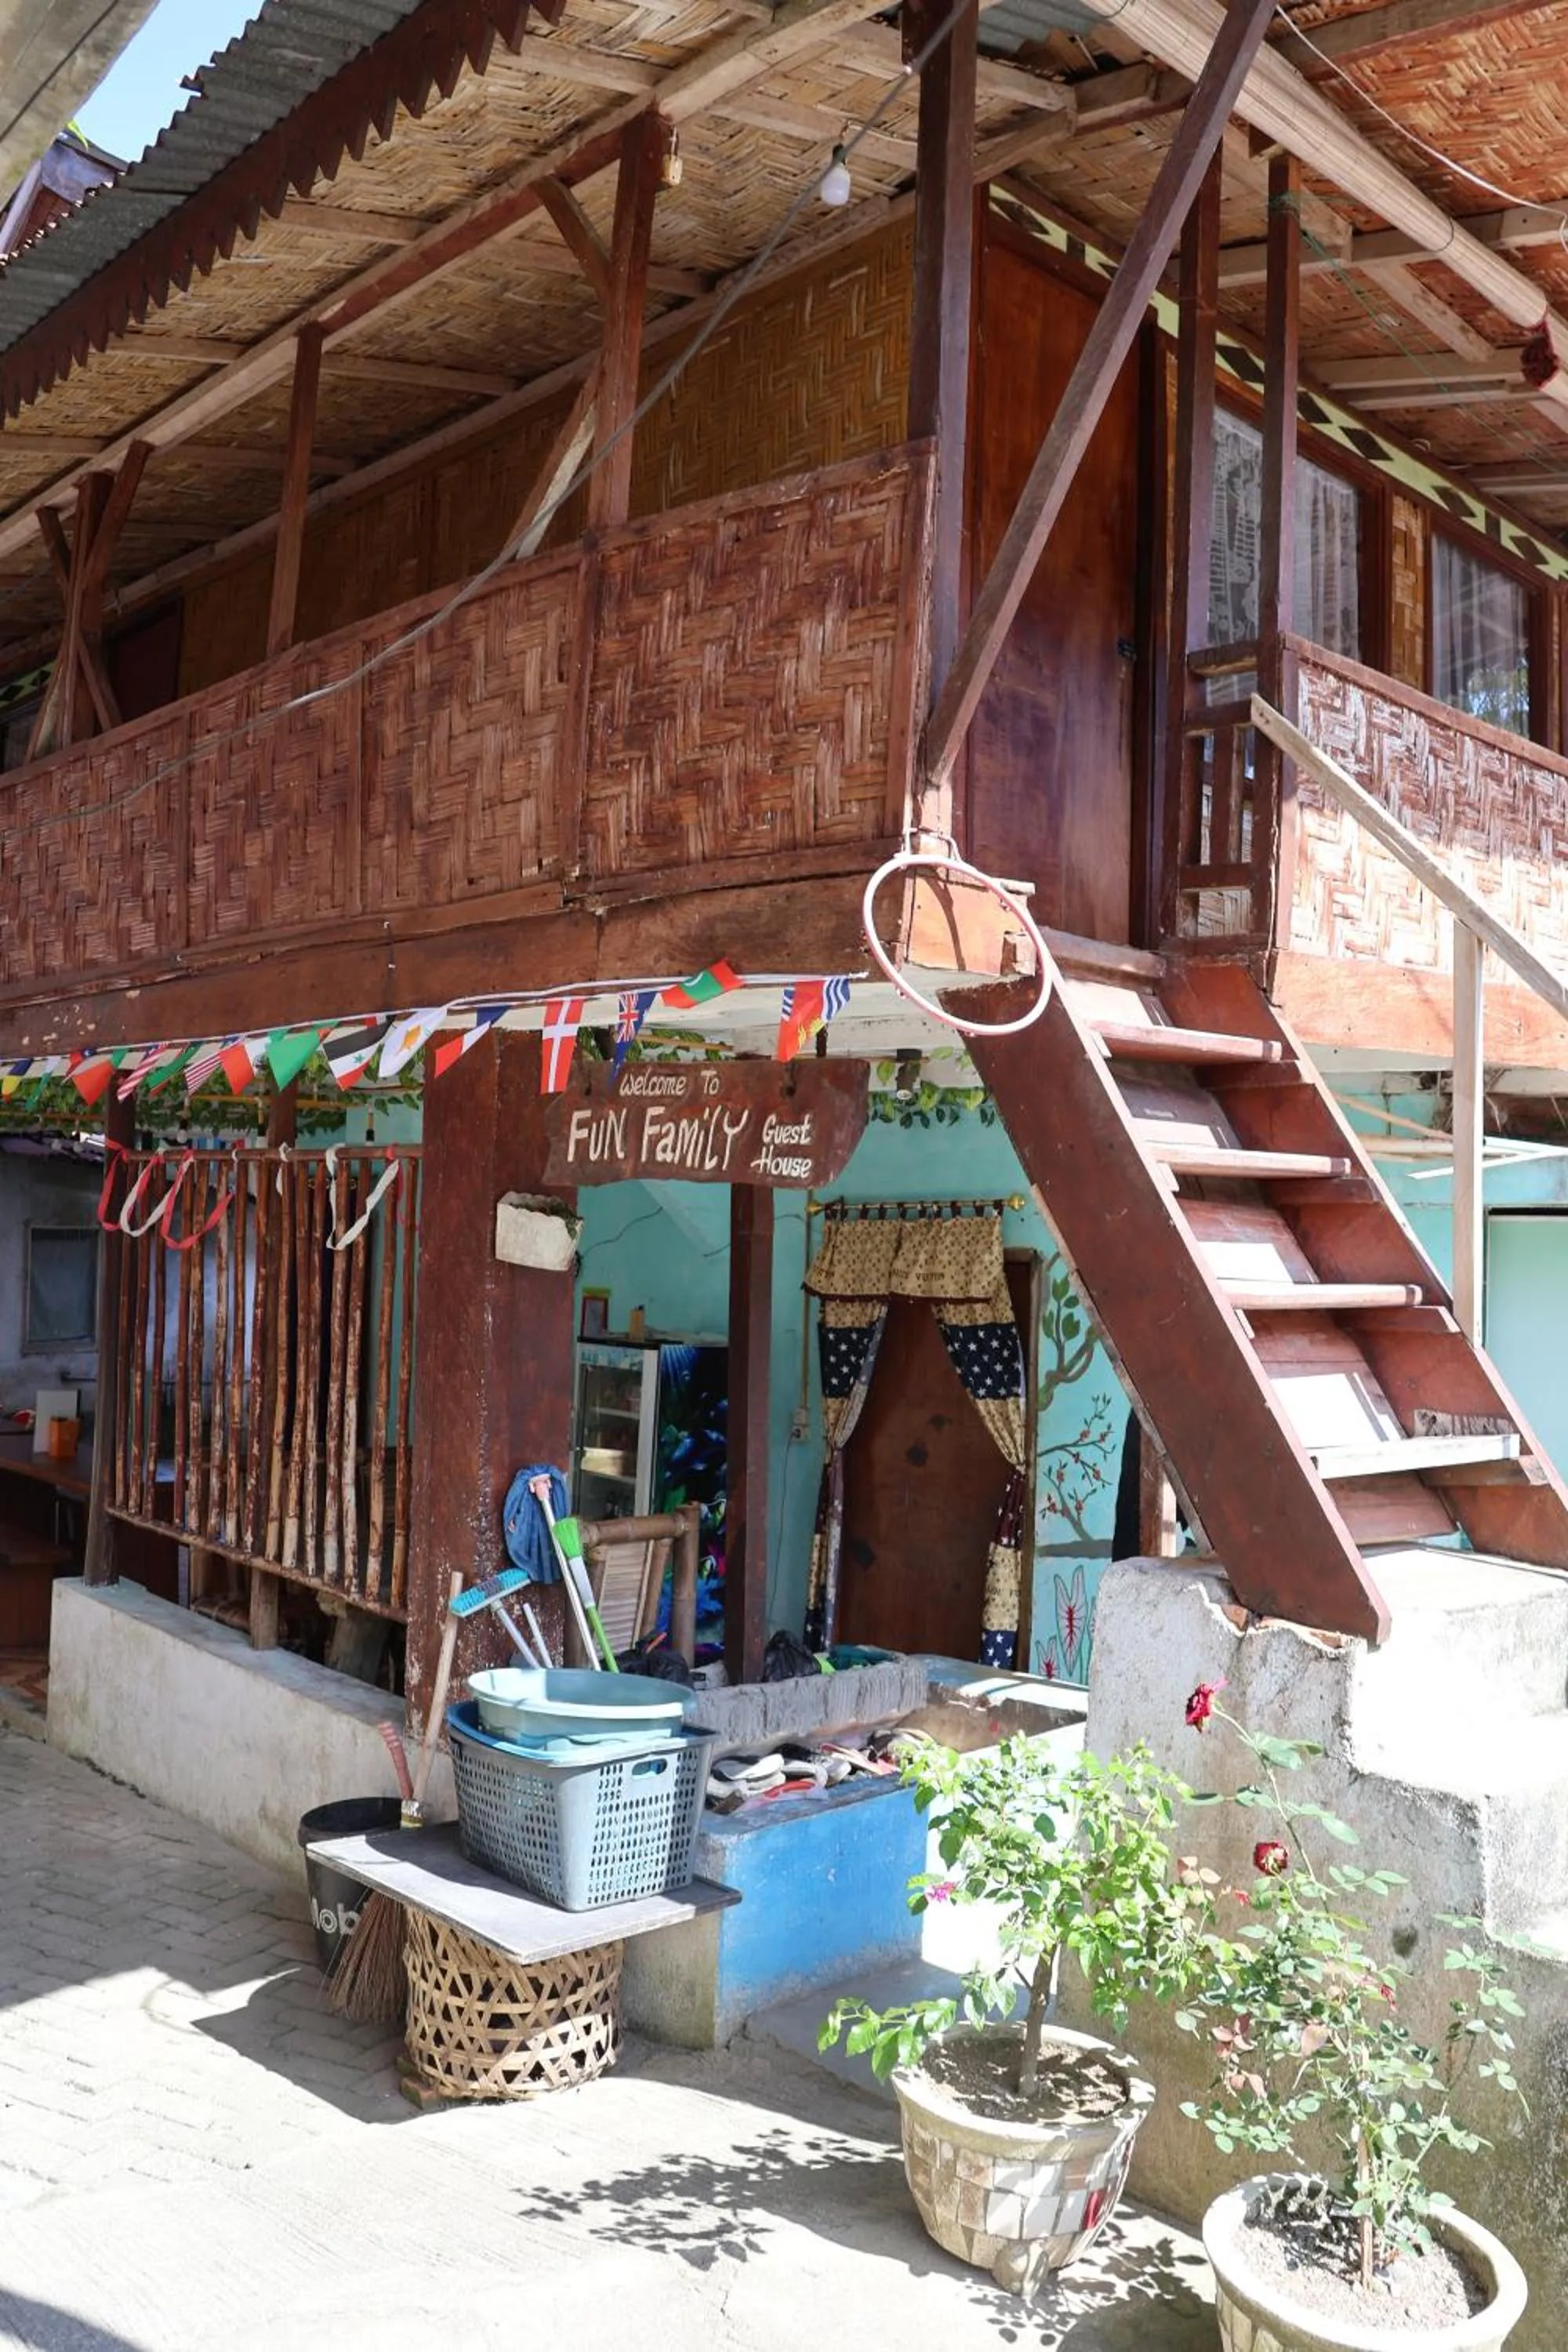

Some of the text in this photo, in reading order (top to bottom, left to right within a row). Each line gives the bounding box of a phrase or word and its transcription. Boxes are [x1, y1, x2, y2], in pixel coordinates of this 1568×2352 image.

[700, 1069, 720, 1095] To
[762, 1113, 811, 1146] Guest
[750, 1145, 812, 1178] House
